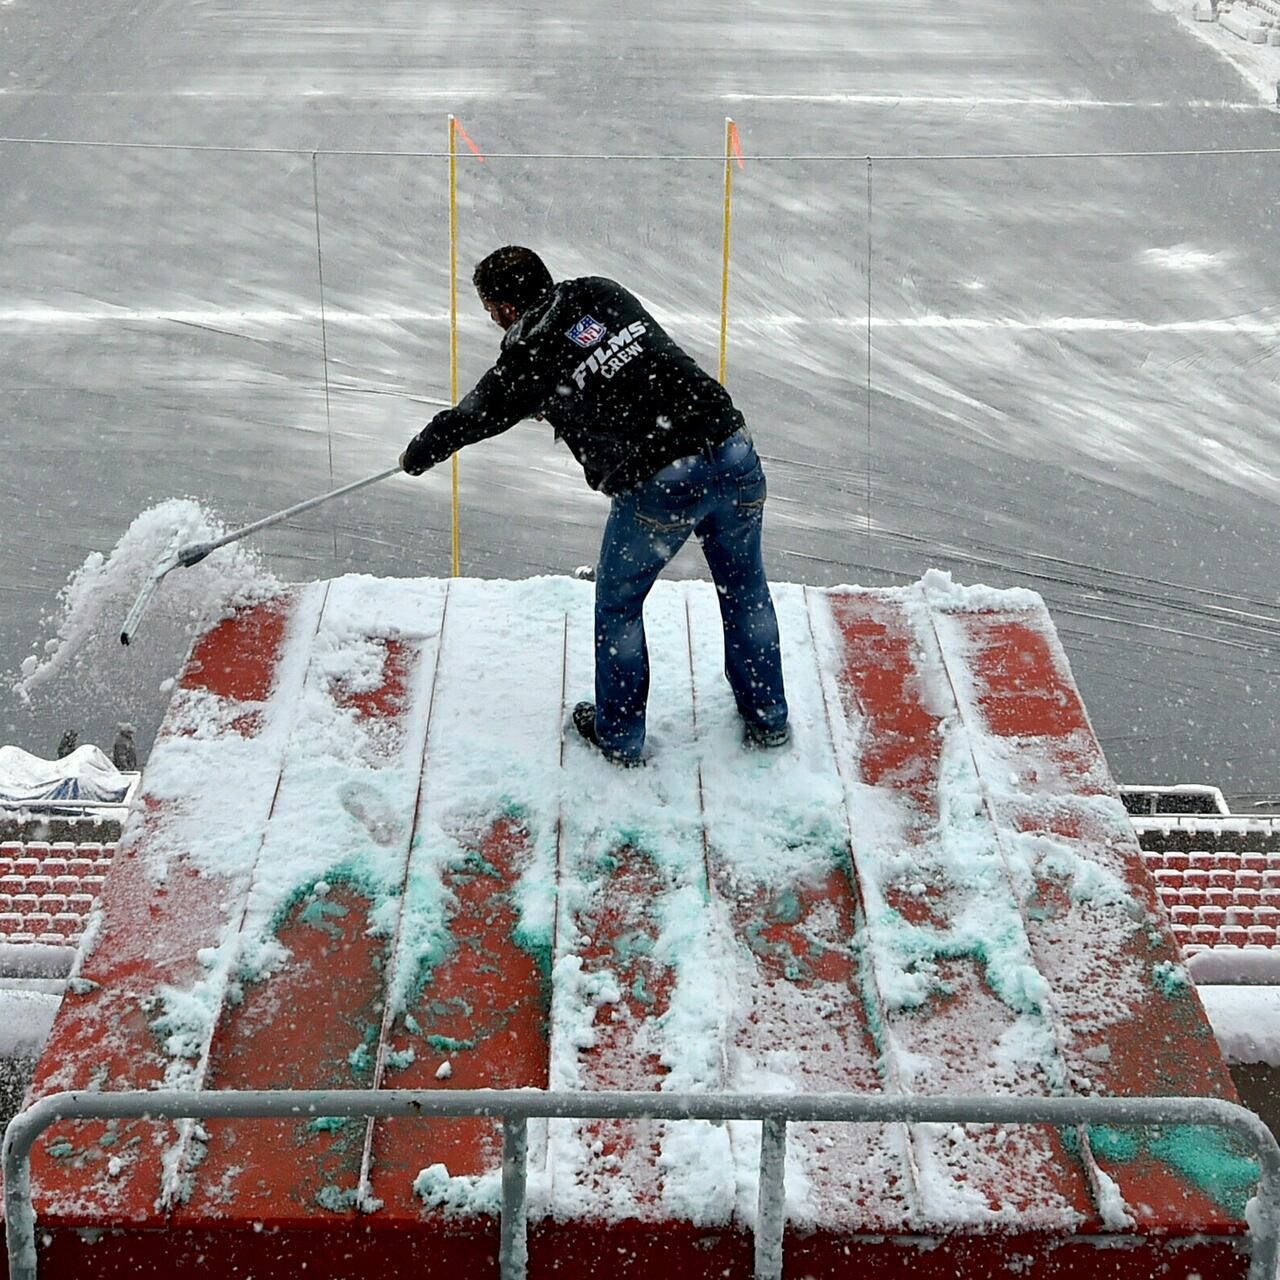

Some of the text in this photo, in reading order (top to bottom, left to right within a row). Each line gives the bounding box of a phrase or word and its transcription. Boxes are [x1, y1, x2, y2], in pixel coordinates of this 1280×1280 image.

[578, 326, 602, 343] NFL
[571, 320, 646, 390] FILMS
[600, 341, 643, 379] CREW
